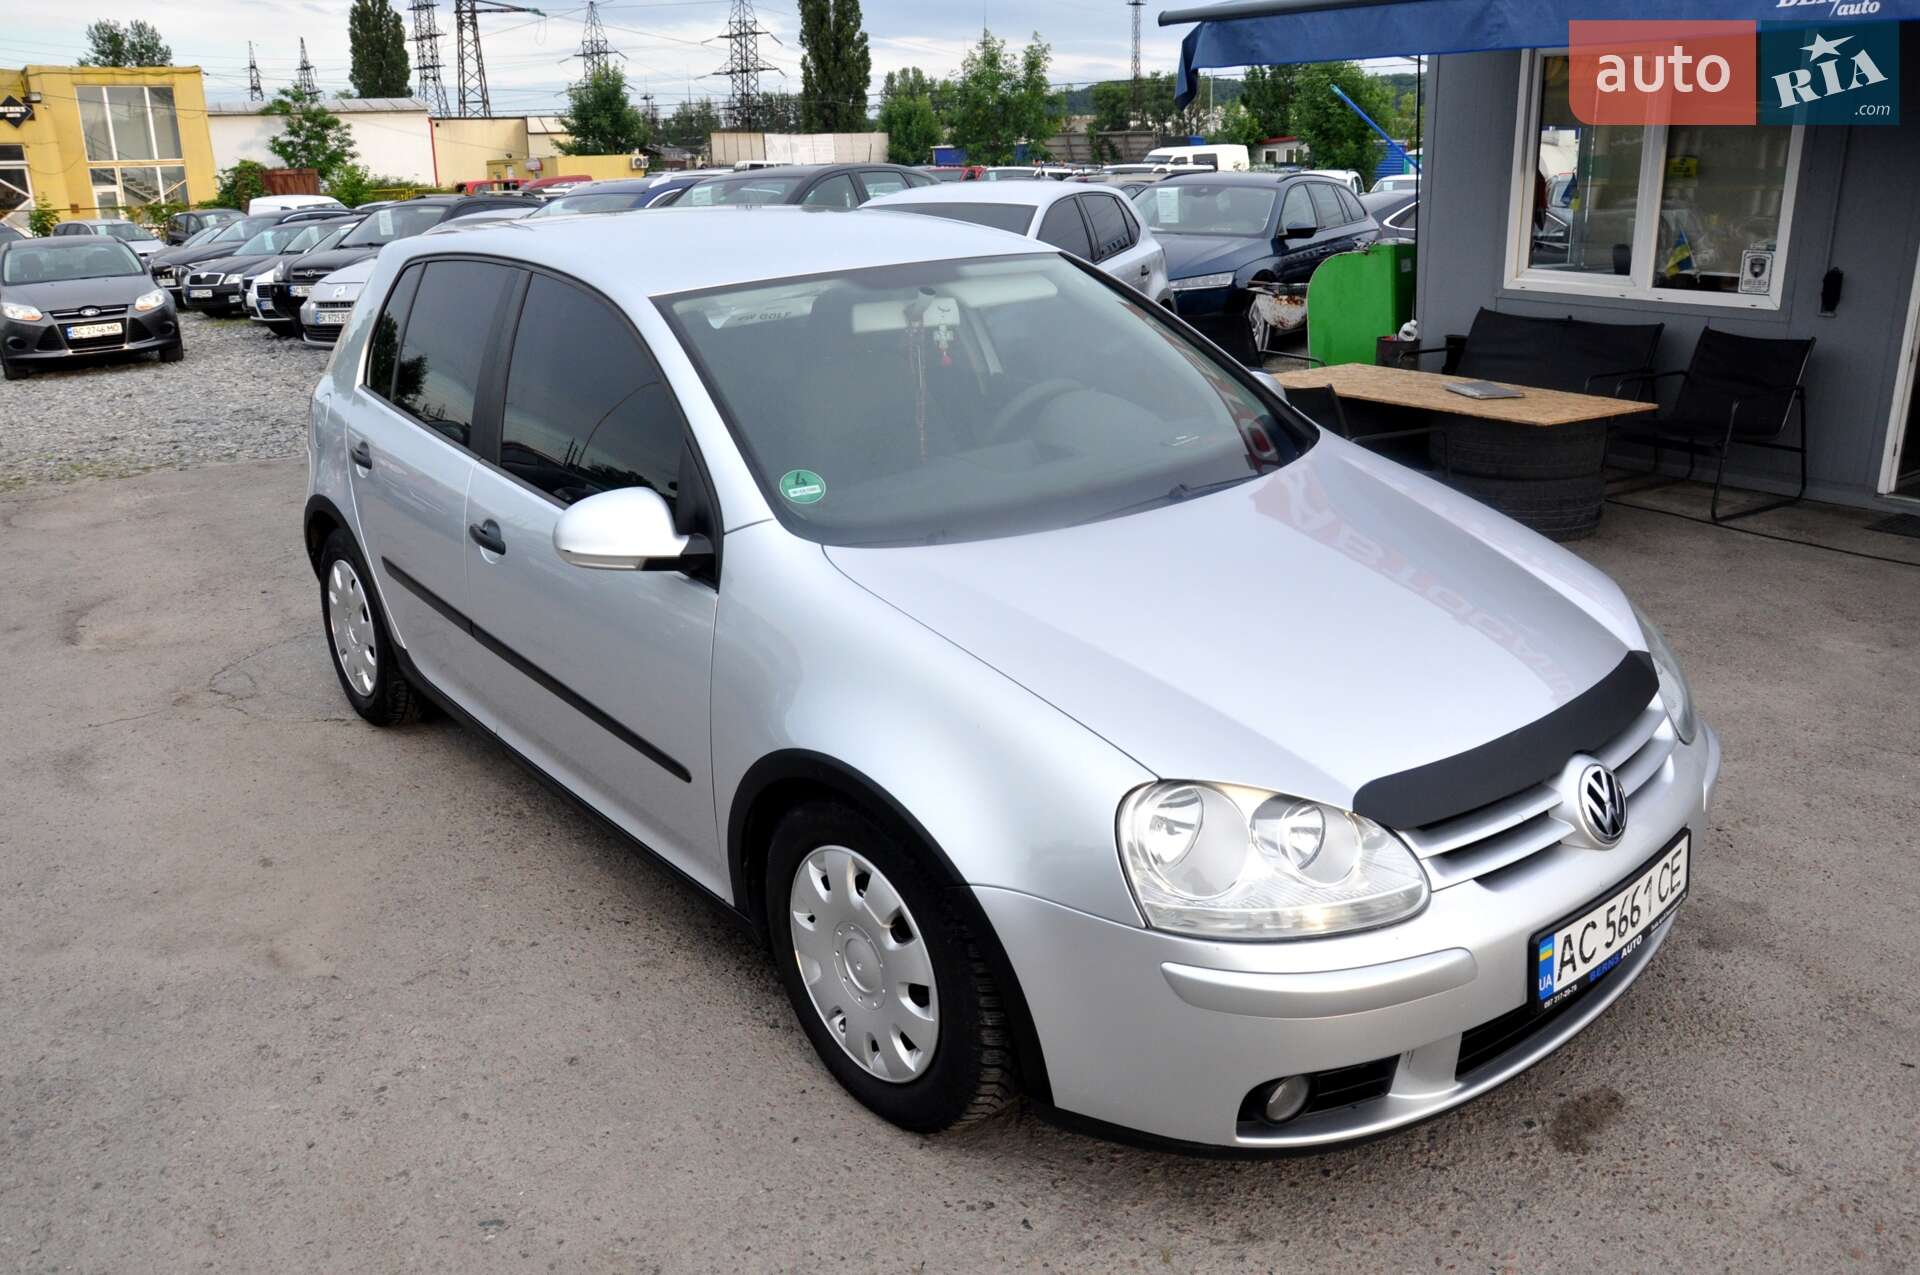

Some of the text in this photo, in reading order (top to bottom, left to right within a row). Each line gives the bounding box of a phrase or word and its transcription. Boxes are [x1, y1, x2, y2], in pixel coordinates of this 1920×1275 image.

[795, 472, 807, 486] 4
[1557, 920, 1597, 982] AC
[1604, 875, 1653, 949] 5661
[1658, 848, 1682, 902] CE
[1621, 934, 1643, 959] AUTO
[1538, 973, 1553, 991] UA
